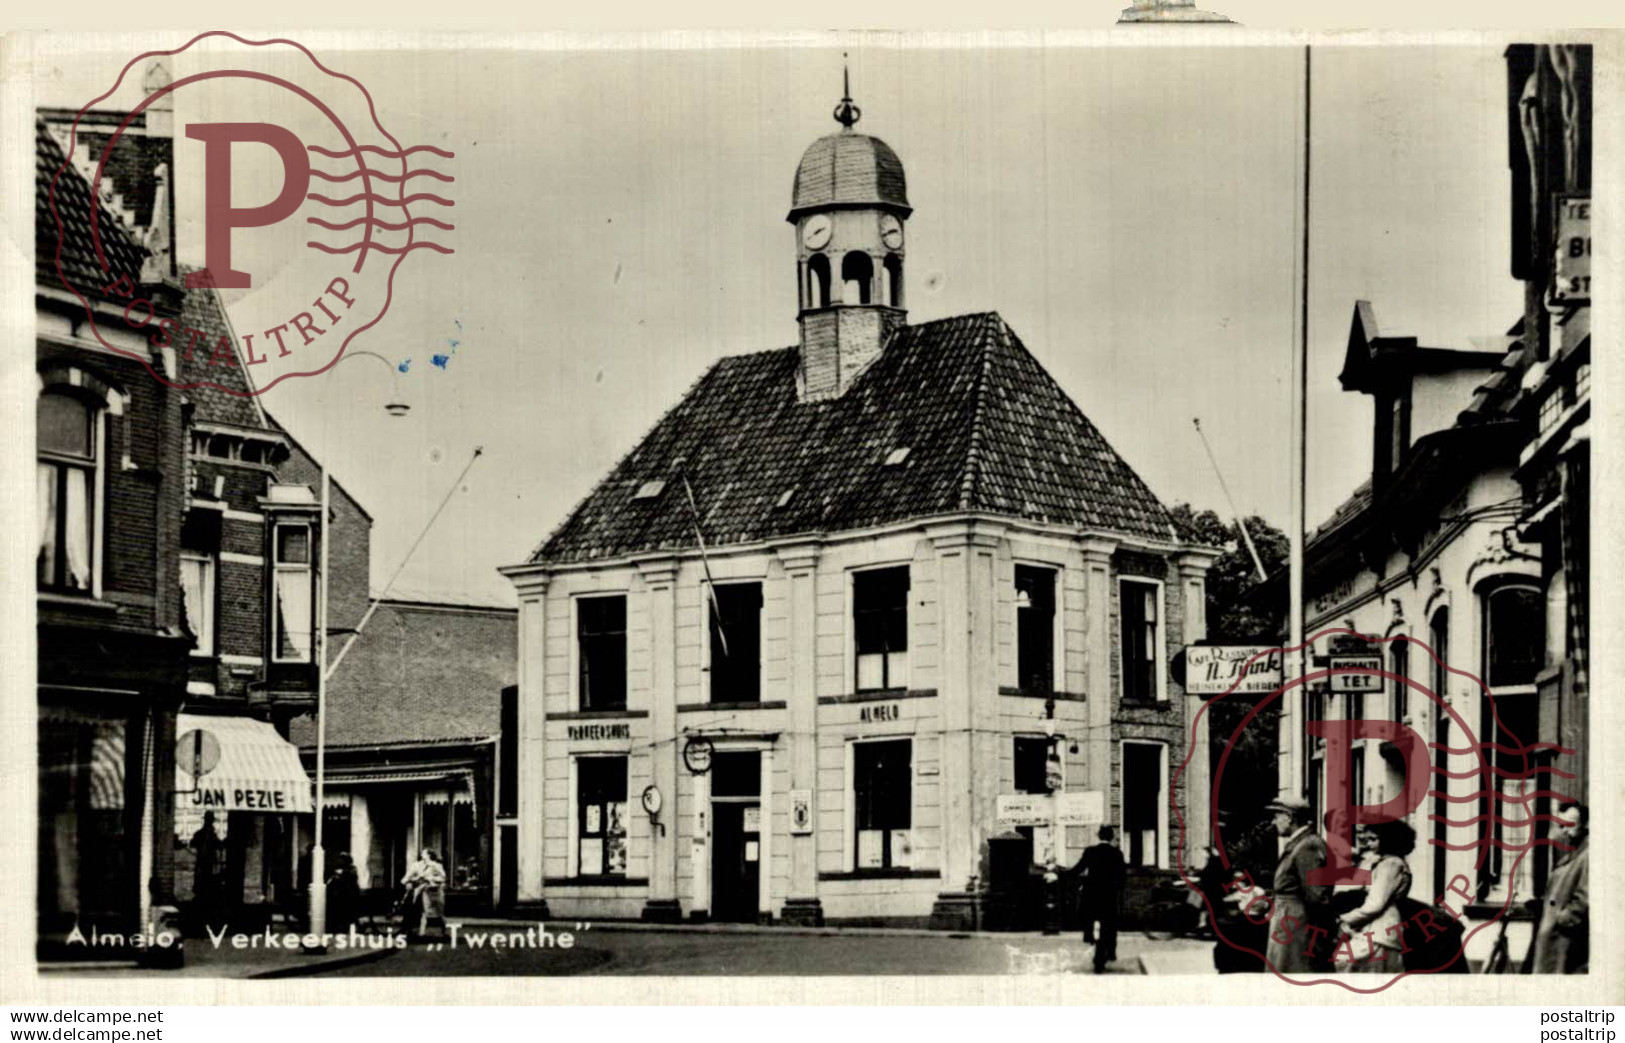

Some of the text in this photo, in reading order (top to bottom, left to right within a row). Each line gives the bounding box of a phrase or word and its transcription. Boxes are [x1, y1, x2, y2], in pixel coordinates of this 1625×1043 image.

[860, 704, 899, 723] ALMELO
[192, 788, 285, 809] JAN PEZIE
